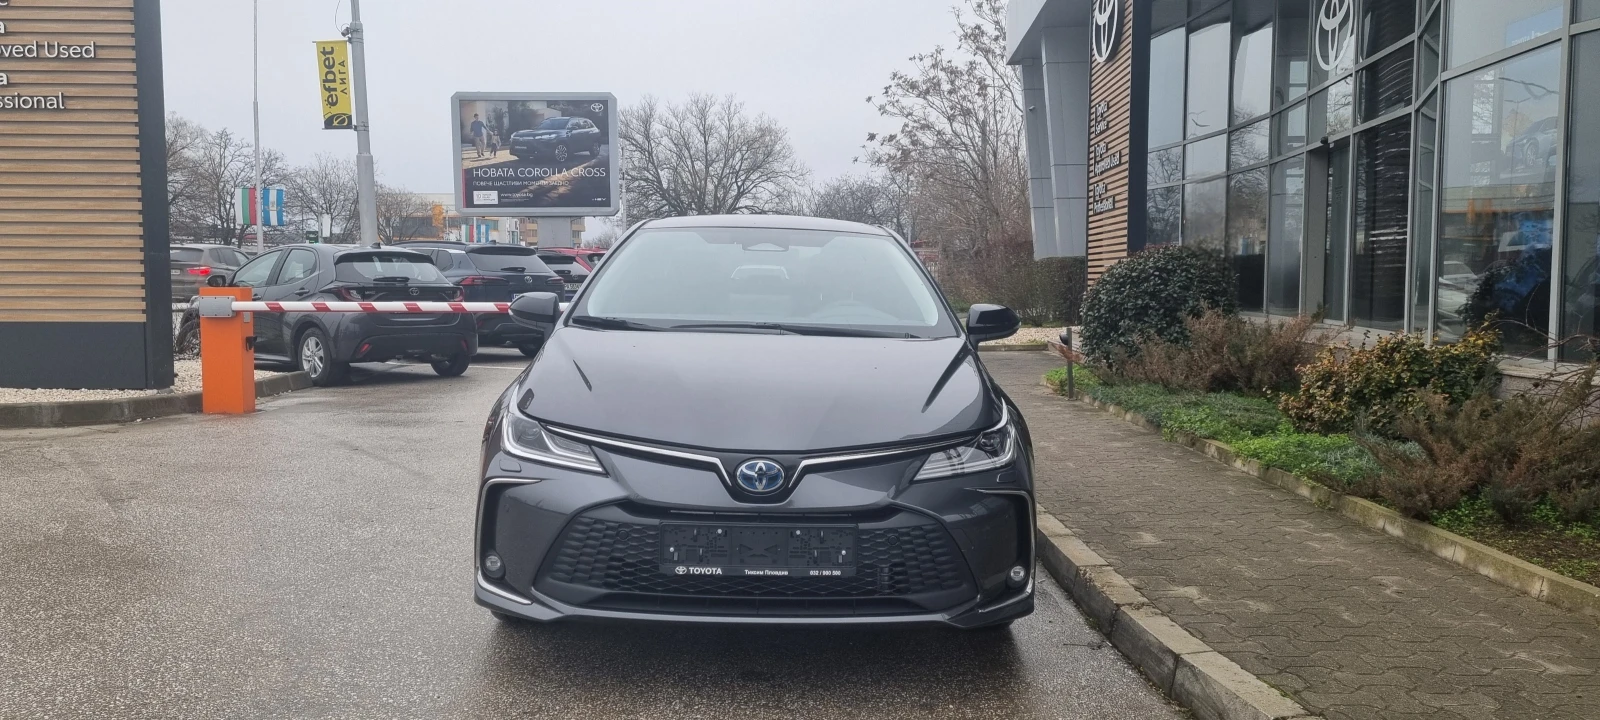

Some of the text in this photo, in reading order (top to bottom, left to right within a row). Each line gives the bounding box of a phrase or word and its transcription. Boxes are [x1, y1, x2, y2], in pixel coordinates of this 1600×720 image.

[0, 40, 94, 57] ved Used
[320, 46, 339, 107] efbet
[473, 167, 606, 178] НОВАТА COROLLA CROSS
[688, 567, 722, 575] TOYOTA
